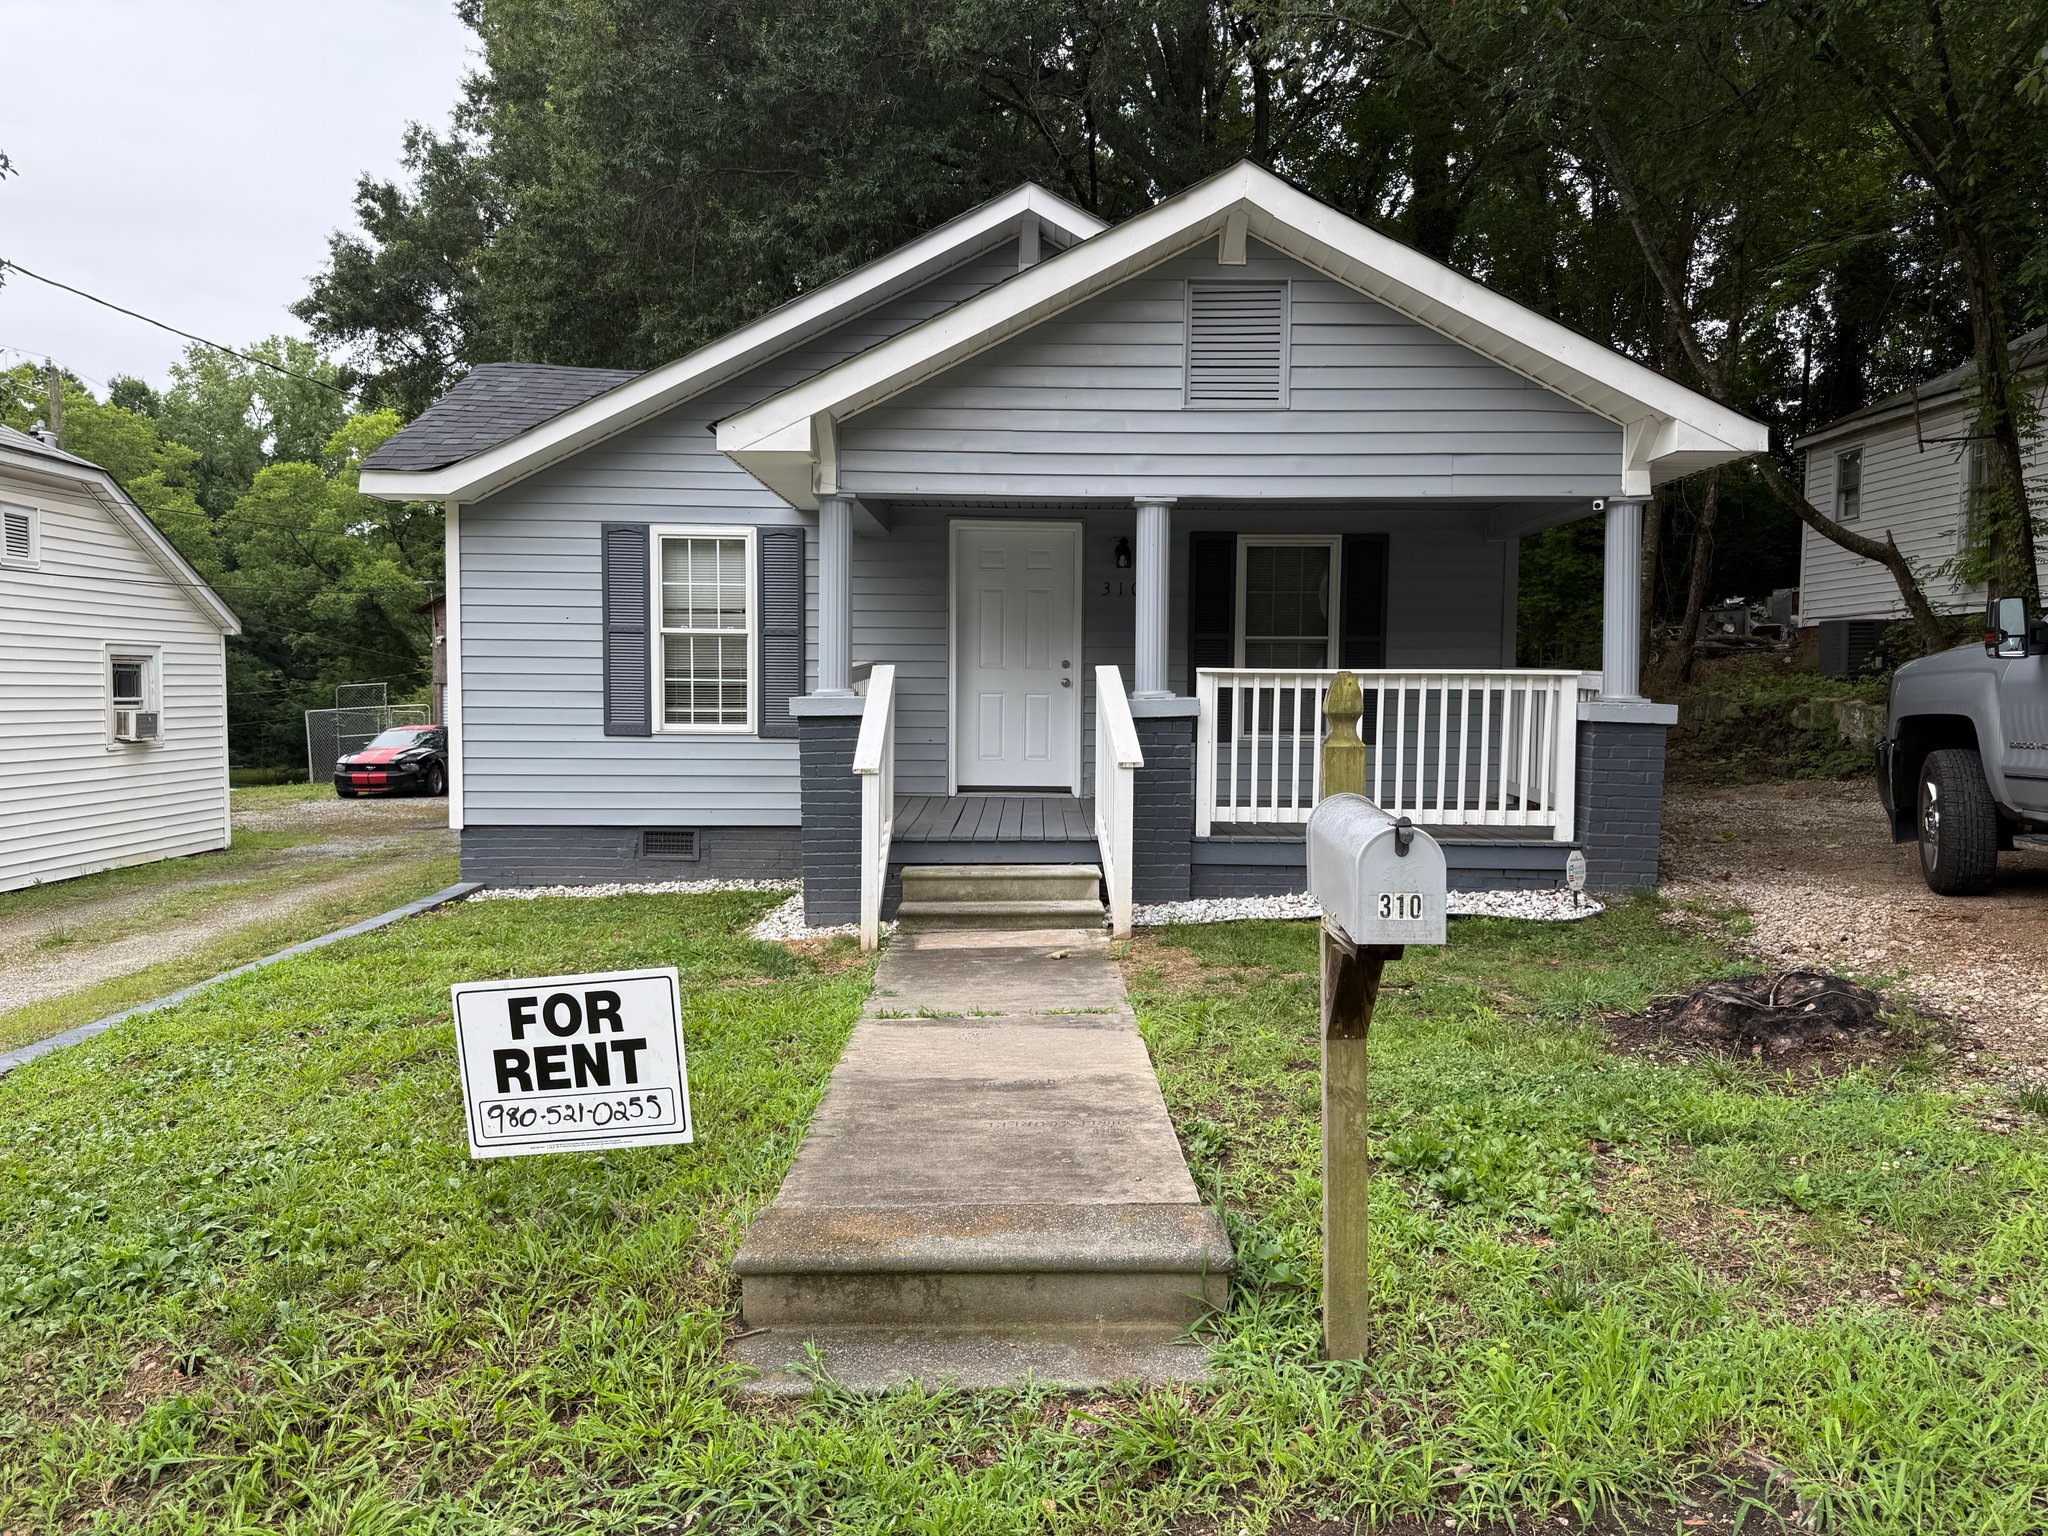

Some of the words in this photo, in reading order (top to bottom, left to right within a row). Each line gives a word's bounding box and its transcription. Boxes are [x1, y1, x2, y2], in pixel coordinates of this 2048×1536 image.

[1380, 894, 1422, 919] 310
[508, 990, 624, 1040] FOR
[493, 1038, 647, 1093] RENT
[487, 1095, 662, 1133] 980-521-0255
